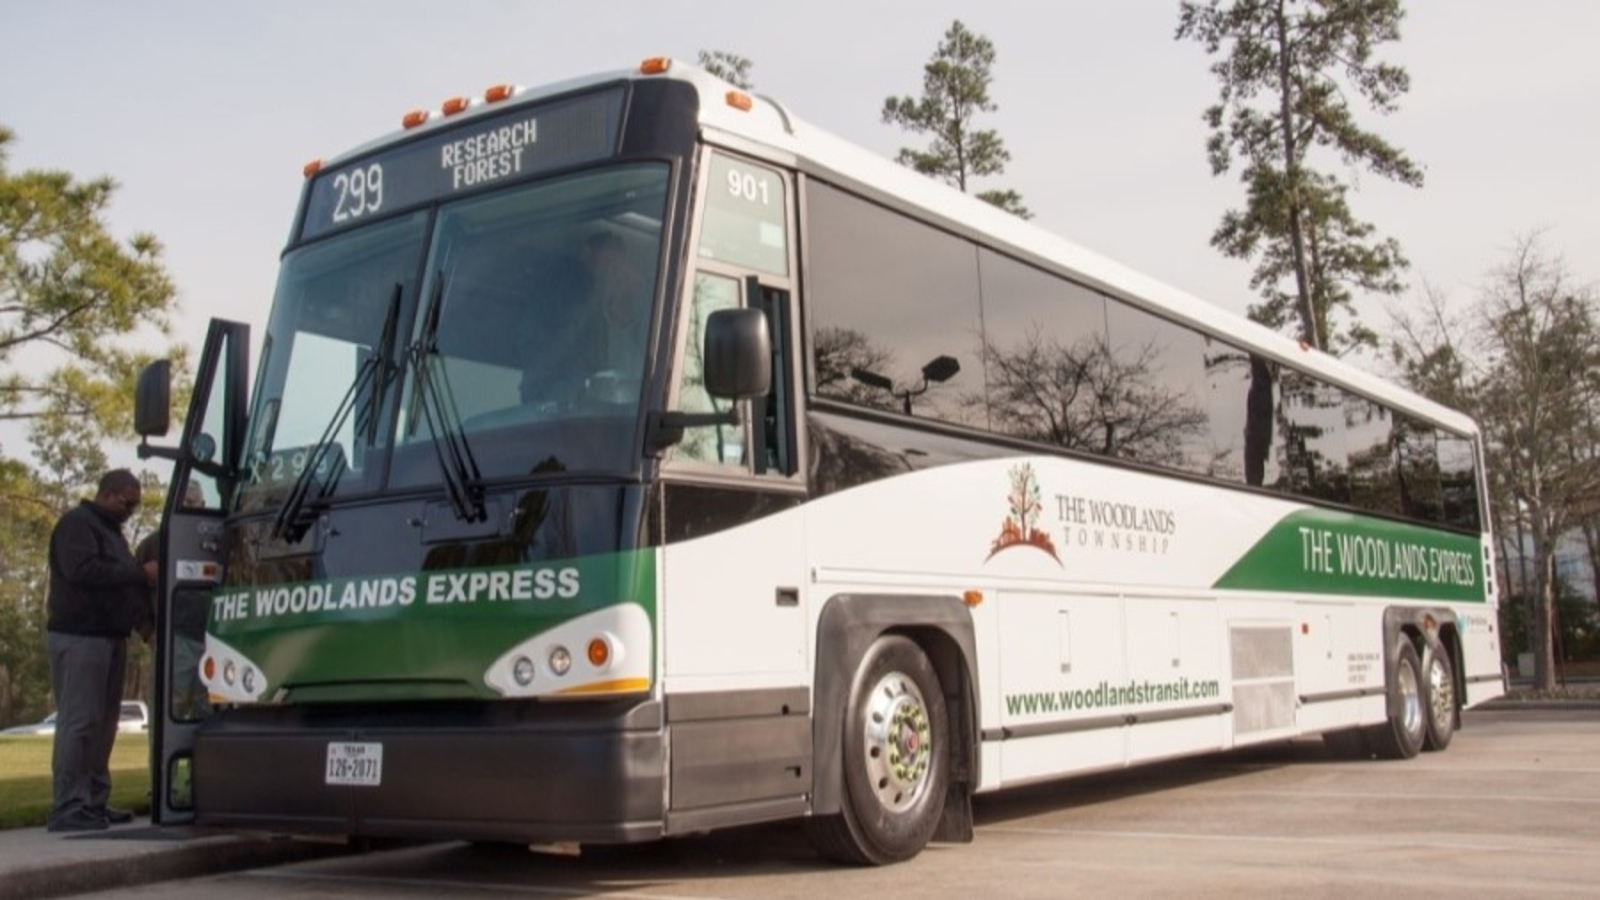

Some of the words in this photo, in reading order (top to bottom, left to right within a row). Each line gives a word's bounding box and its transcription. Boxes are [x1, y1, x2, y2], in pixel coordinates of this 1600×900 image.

[441, 118, 538, 169] RESEARCH
[453, 149, 523, 189] FOREST
[727, 168, 770, 206] 901
[332, 163, 383, 223] 299
[1055, 494, 1087, 524] THE
[1088, 499, 1177, 535] WOODLANDS
[1063, 526, 1169, 555] TOWNSHIP
[1299, 527, 1334, 574] THE
[1337, 533, 1429, 582] WOODLANDS
[1430, 547, 1475, 587] EXPRESS
[213, 592, 249, 622] THE
[255, 576, 417, 617] WOODLANDS
[425, 567, 581, 604] EXPRESS
[1006, 677, 1220, 716] www.woodlandstransit.com
